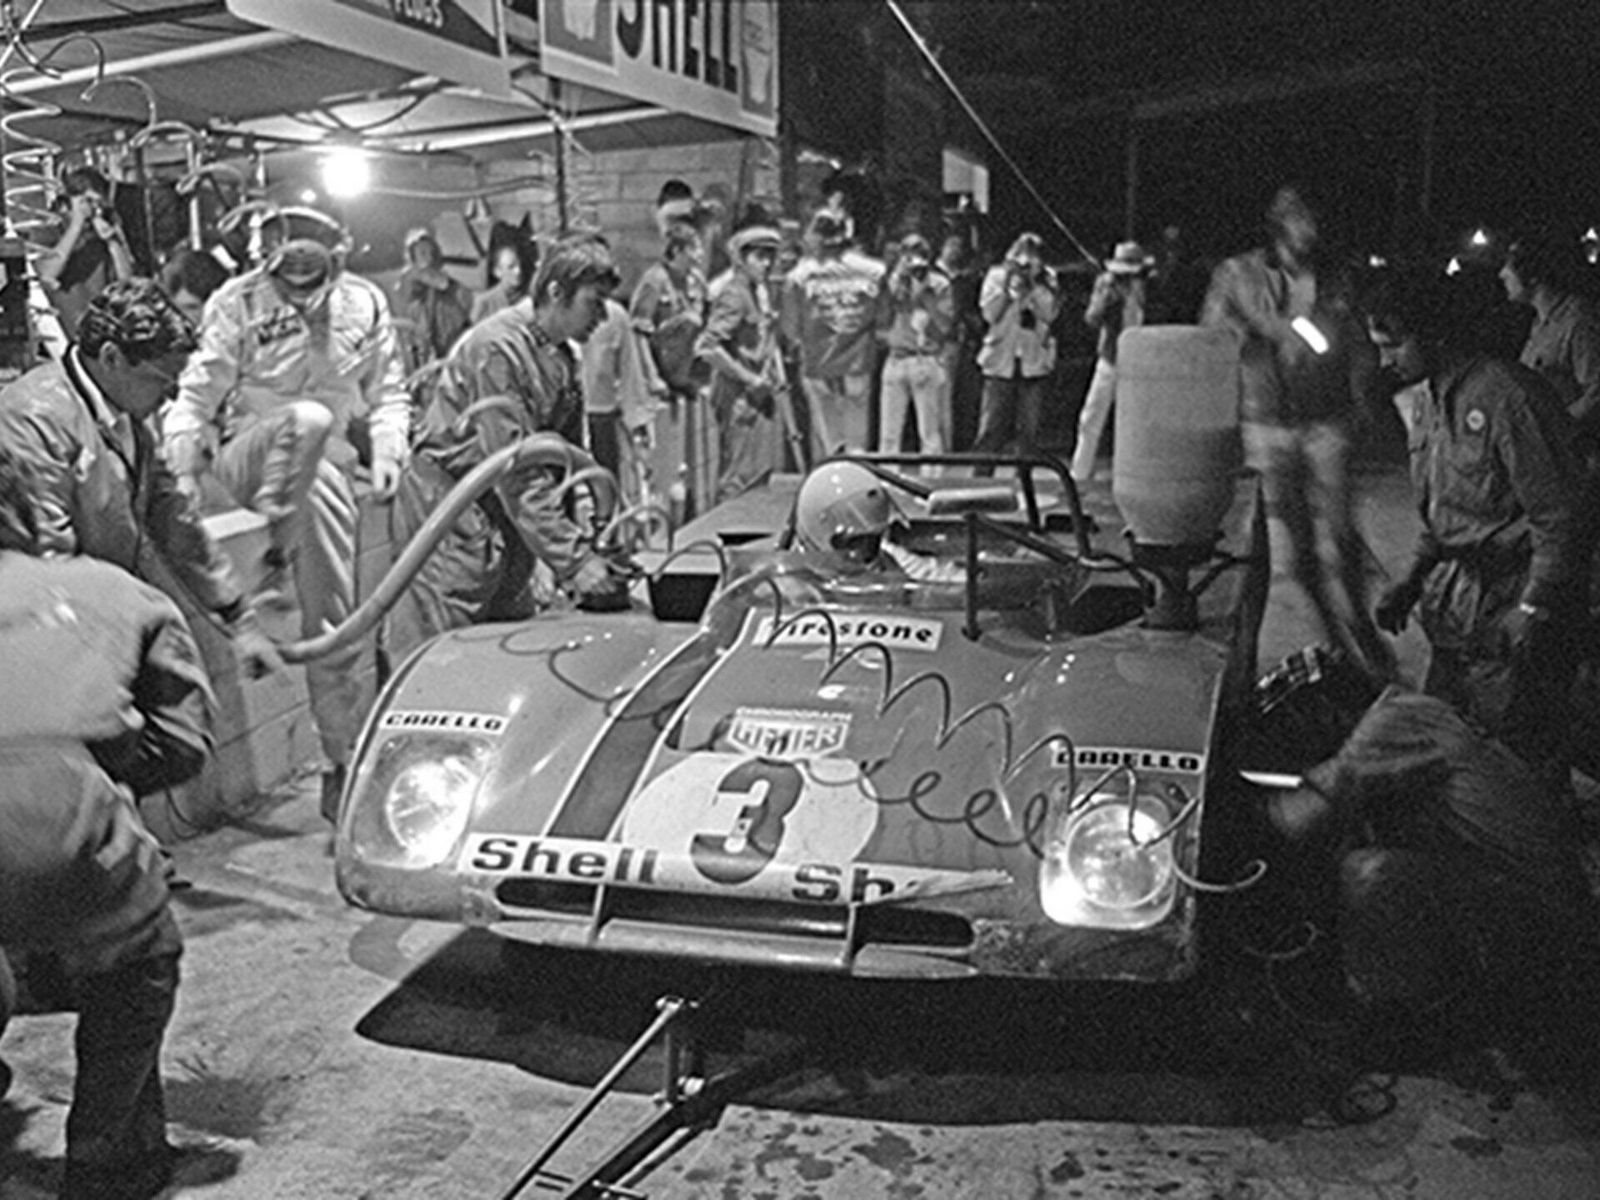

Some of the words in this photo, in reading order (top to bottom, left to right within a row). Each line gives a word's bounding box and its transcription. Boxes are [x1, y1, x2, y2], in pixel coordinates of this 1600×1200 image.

[768, 613, 933, 643] irestone
[689, 756, 804, 887] 3
[472, 838, 659, 885] Shell
